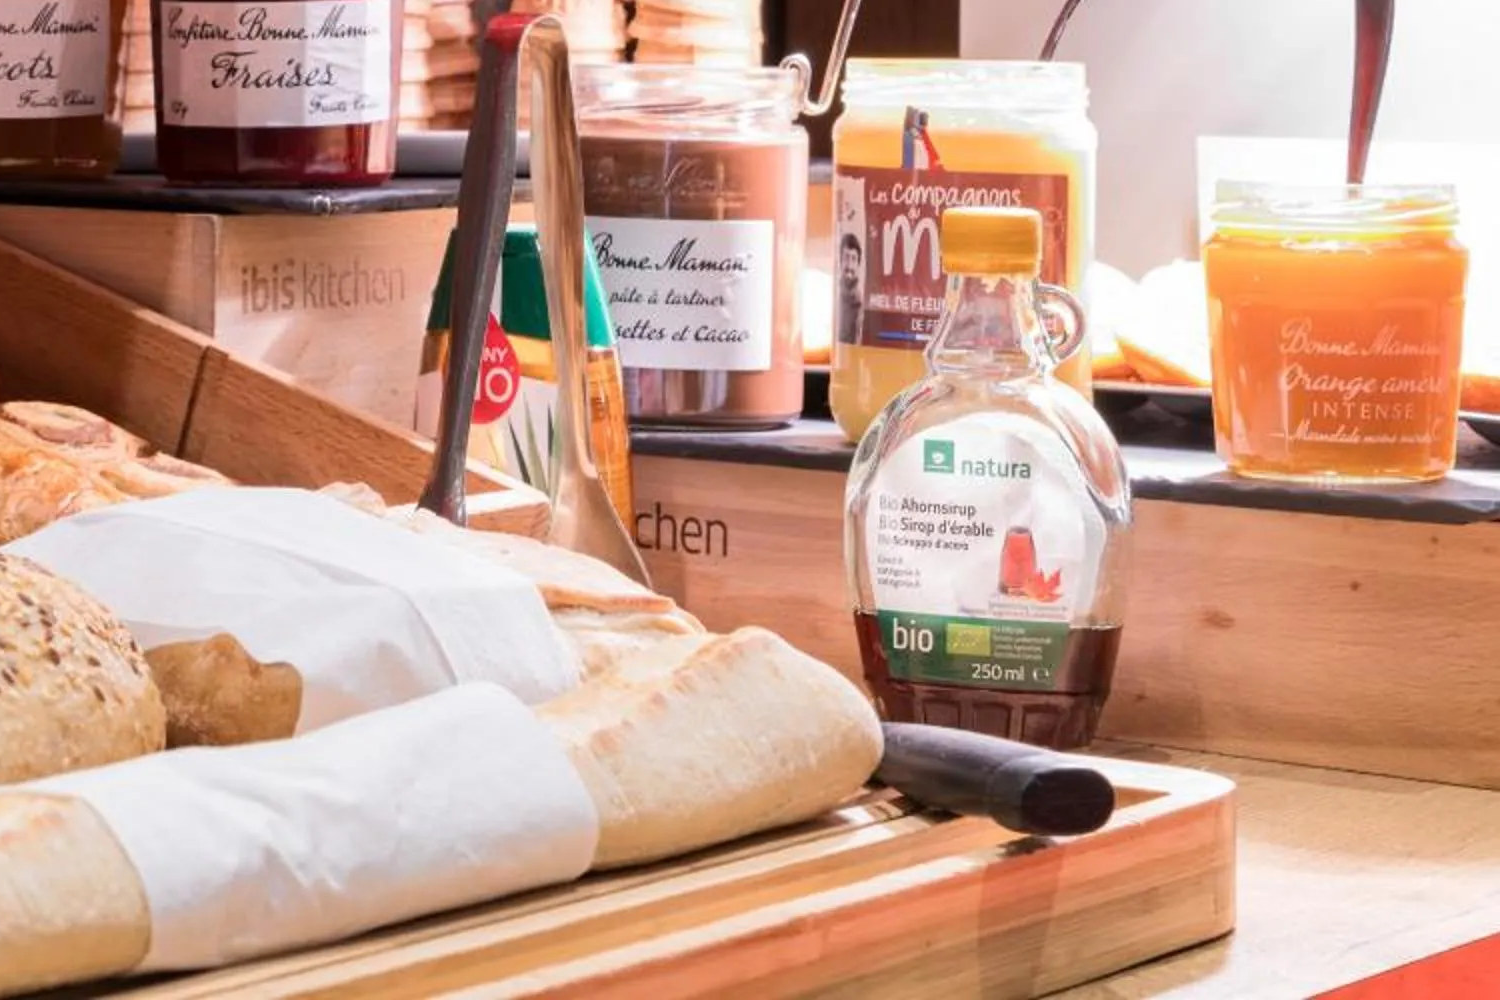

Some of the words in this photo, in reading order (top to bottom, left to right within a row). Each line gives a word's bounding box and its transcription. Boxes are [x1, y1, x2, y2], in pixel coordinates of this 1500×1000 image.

[22, 1, 97, 36] Maman
[235, 6, 308, 41] Bonne
[211, 51, 337, 90] Fraises
[591, 231, 653, 271] Bonne
[655, 236, 750, 272] Maman
[241, 260, 296, 315] ibis
[302, 256, 406, 310] kitchen
[664, 288, 726, 307] tartiner
[613, 319, 666, 341] settes
[694, 325, 749, 343] Cacao
[1312, 400, 1414, 420] INTENSE
[961, 458, 1031, 479] natura
[901, 496, 977, 520] Ahornsirup
[635, 501, 728, 558] chen
[900, 517, 935, 536] Sirop
[938, 519, 995, 538] d'érable
[893, 616, 934, 653] bio
[971, 662, 1002, 680] 250
[1005, 665, 1025, 681] ml
